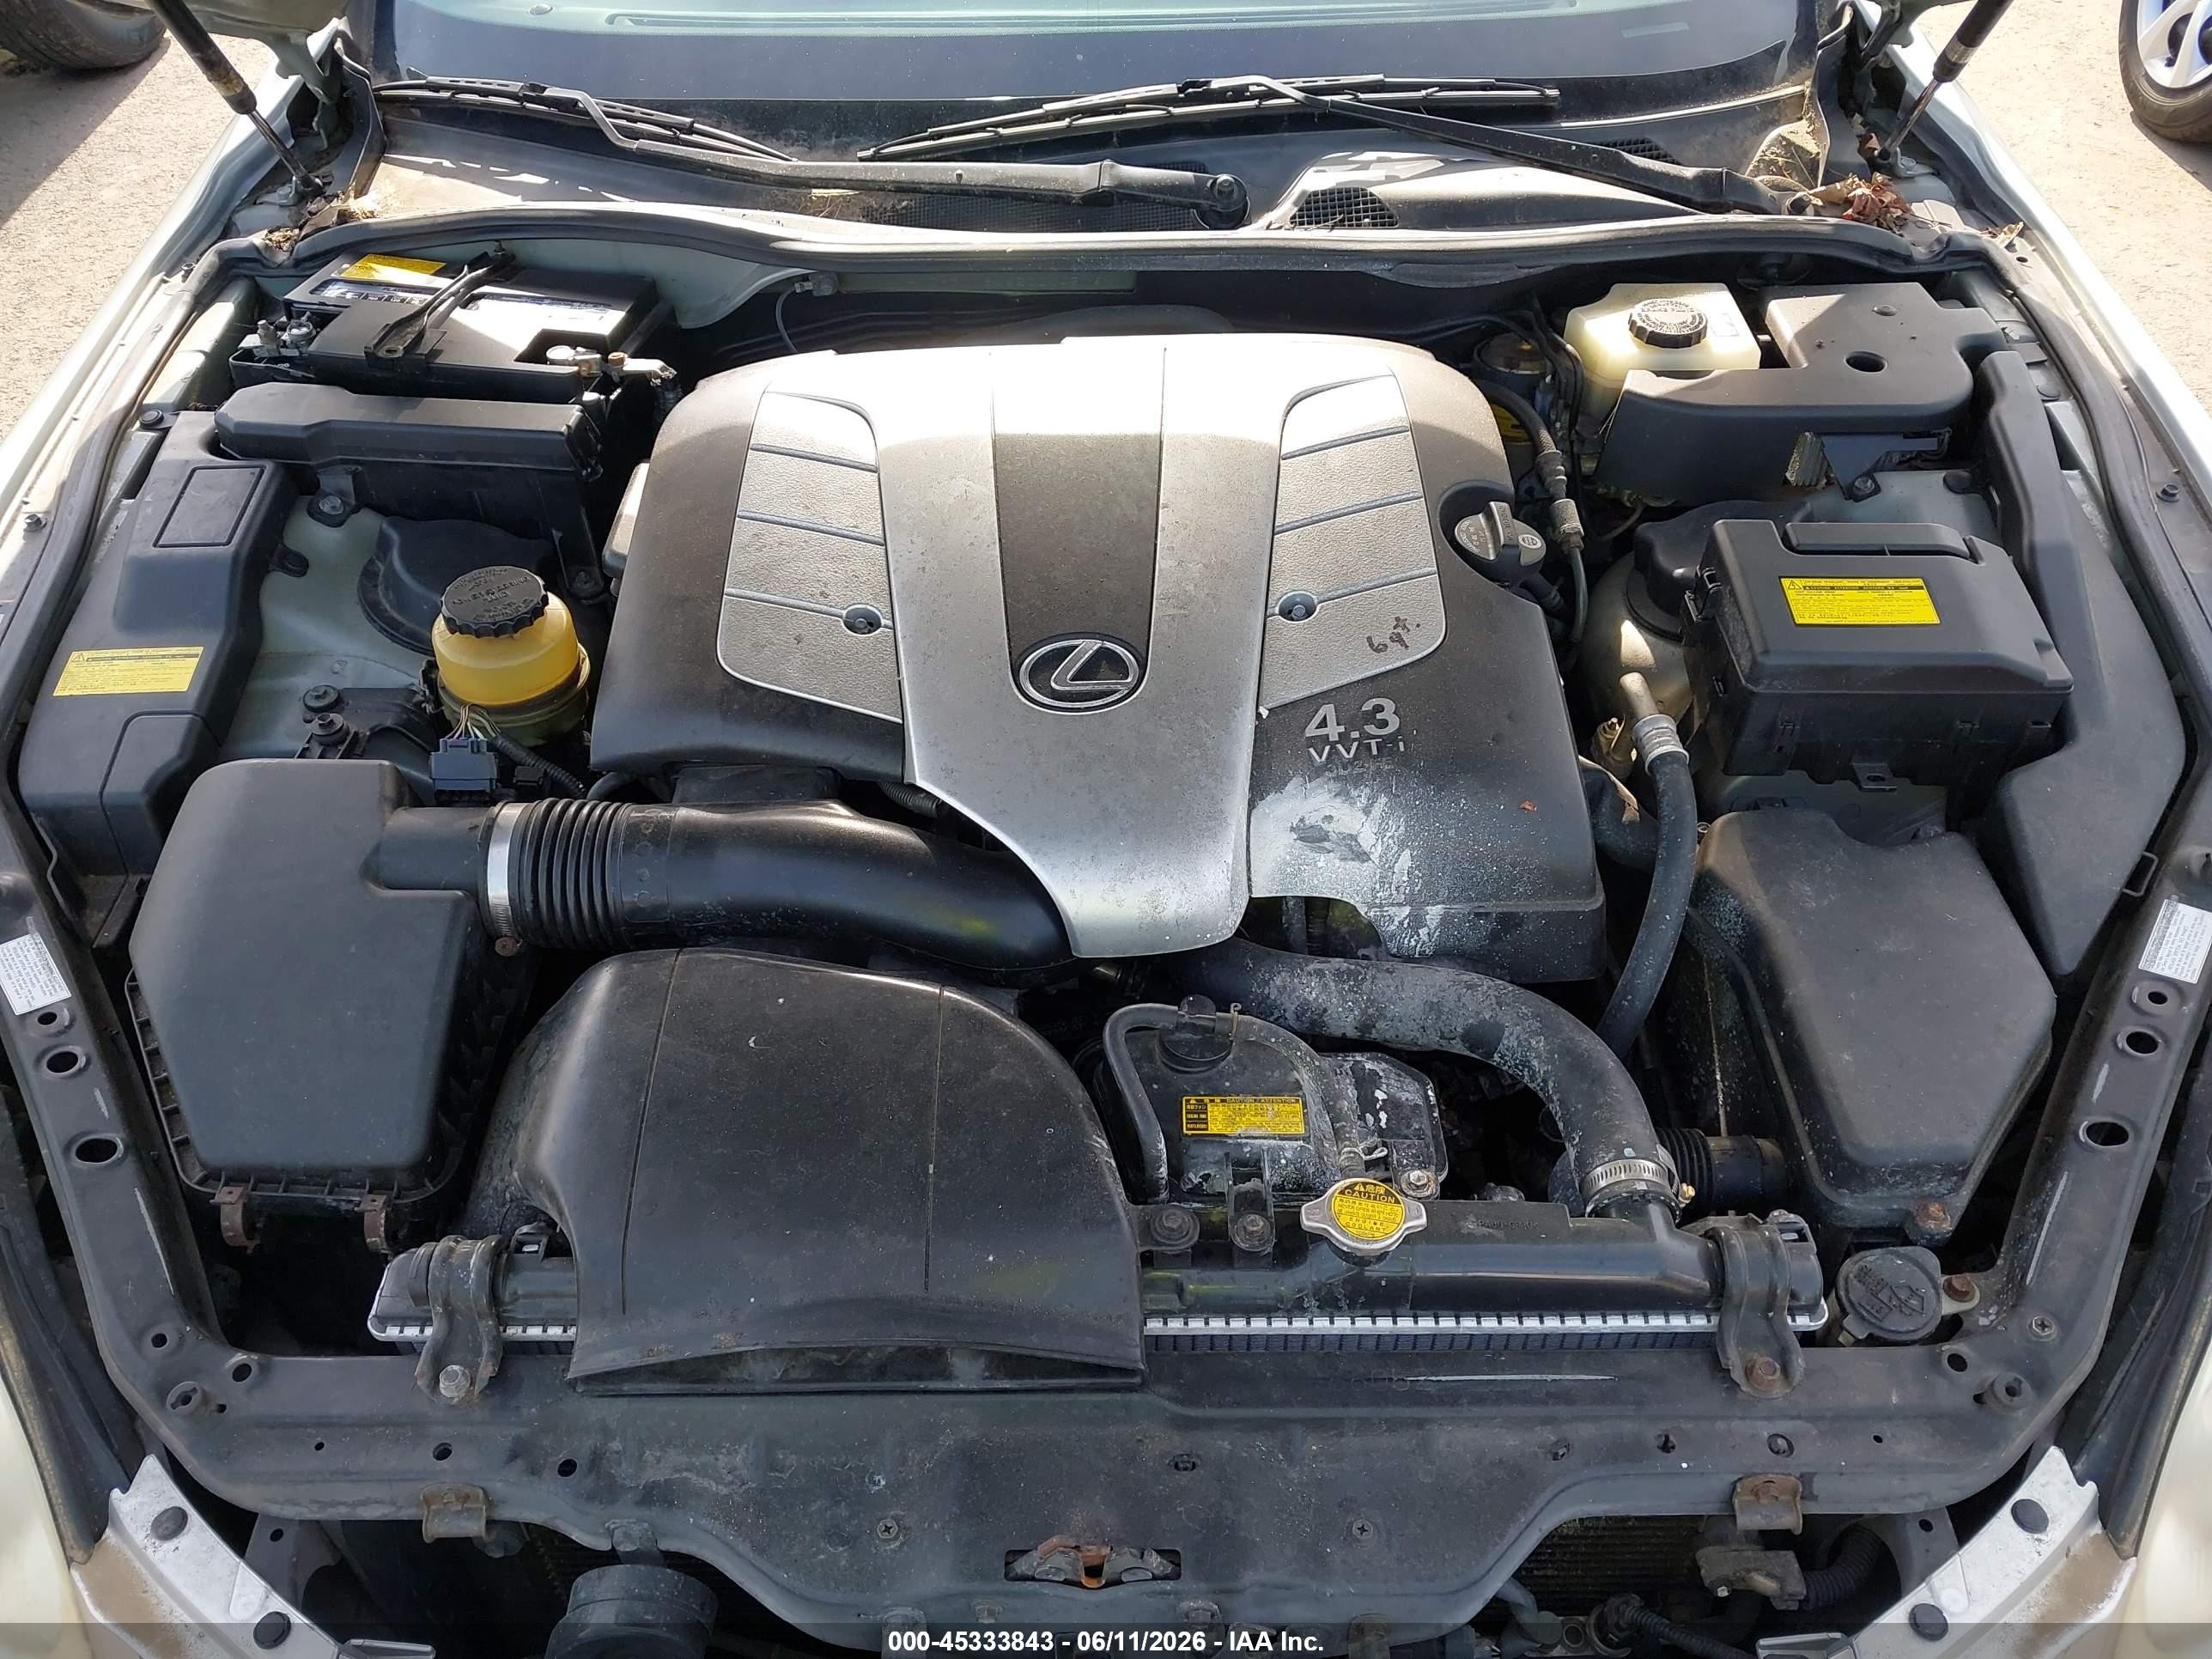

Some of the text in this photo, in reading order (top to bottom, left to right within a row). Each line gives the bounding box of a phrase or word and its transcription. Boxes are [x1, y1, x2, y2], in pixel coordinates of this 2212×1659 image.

[1304, 697, 1401, 742] 4.3
[1308, 735, 1406, 763] VVT-i
[1345, 1189, 1395, 1204] CAUTION
[1346, 1221, 1387, 1232] COOLANT
[1349, 1217, 1384, 1227] ENGINE
